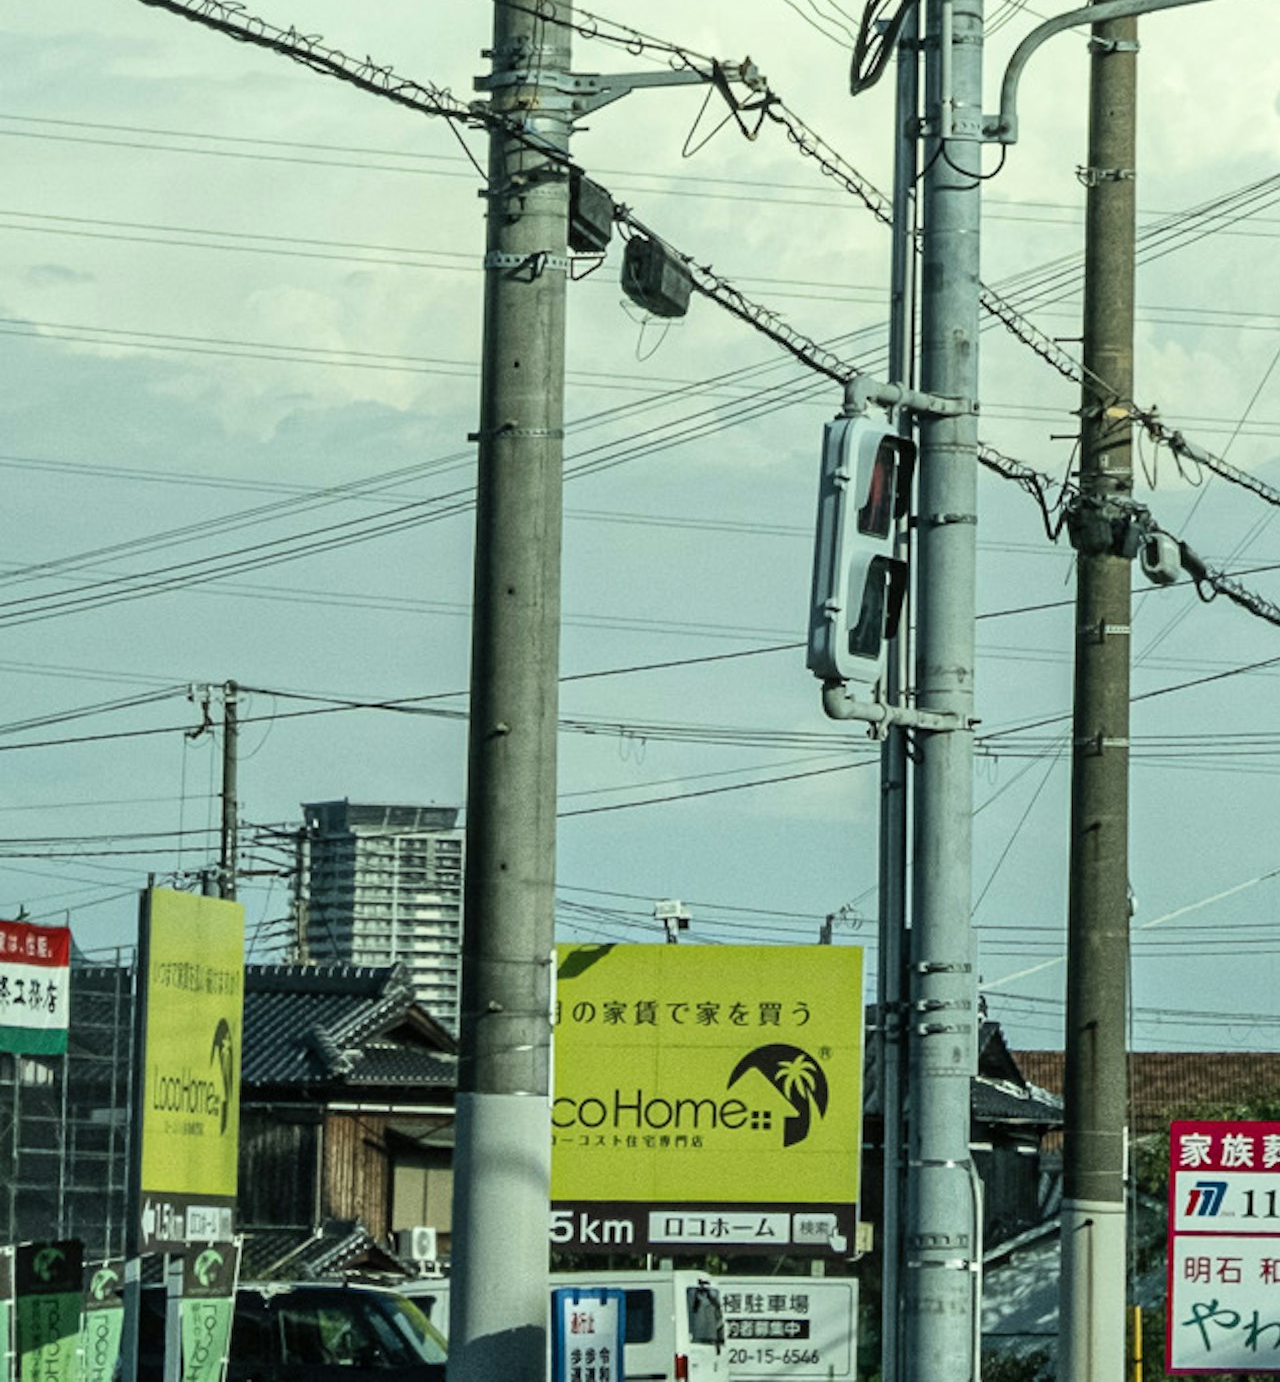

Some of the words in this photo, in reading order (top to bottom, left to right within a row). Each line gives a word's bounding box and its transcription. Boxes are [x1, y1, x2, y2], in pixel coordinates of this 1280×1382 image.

[664, 1217, 776, 1237] ロコホーム
[1184, 1256, 1242, 1284] 明石
[723, 1294, 809, 1314] 極駐車場
[728, 1348, 820, 1364] 20-15-6546
